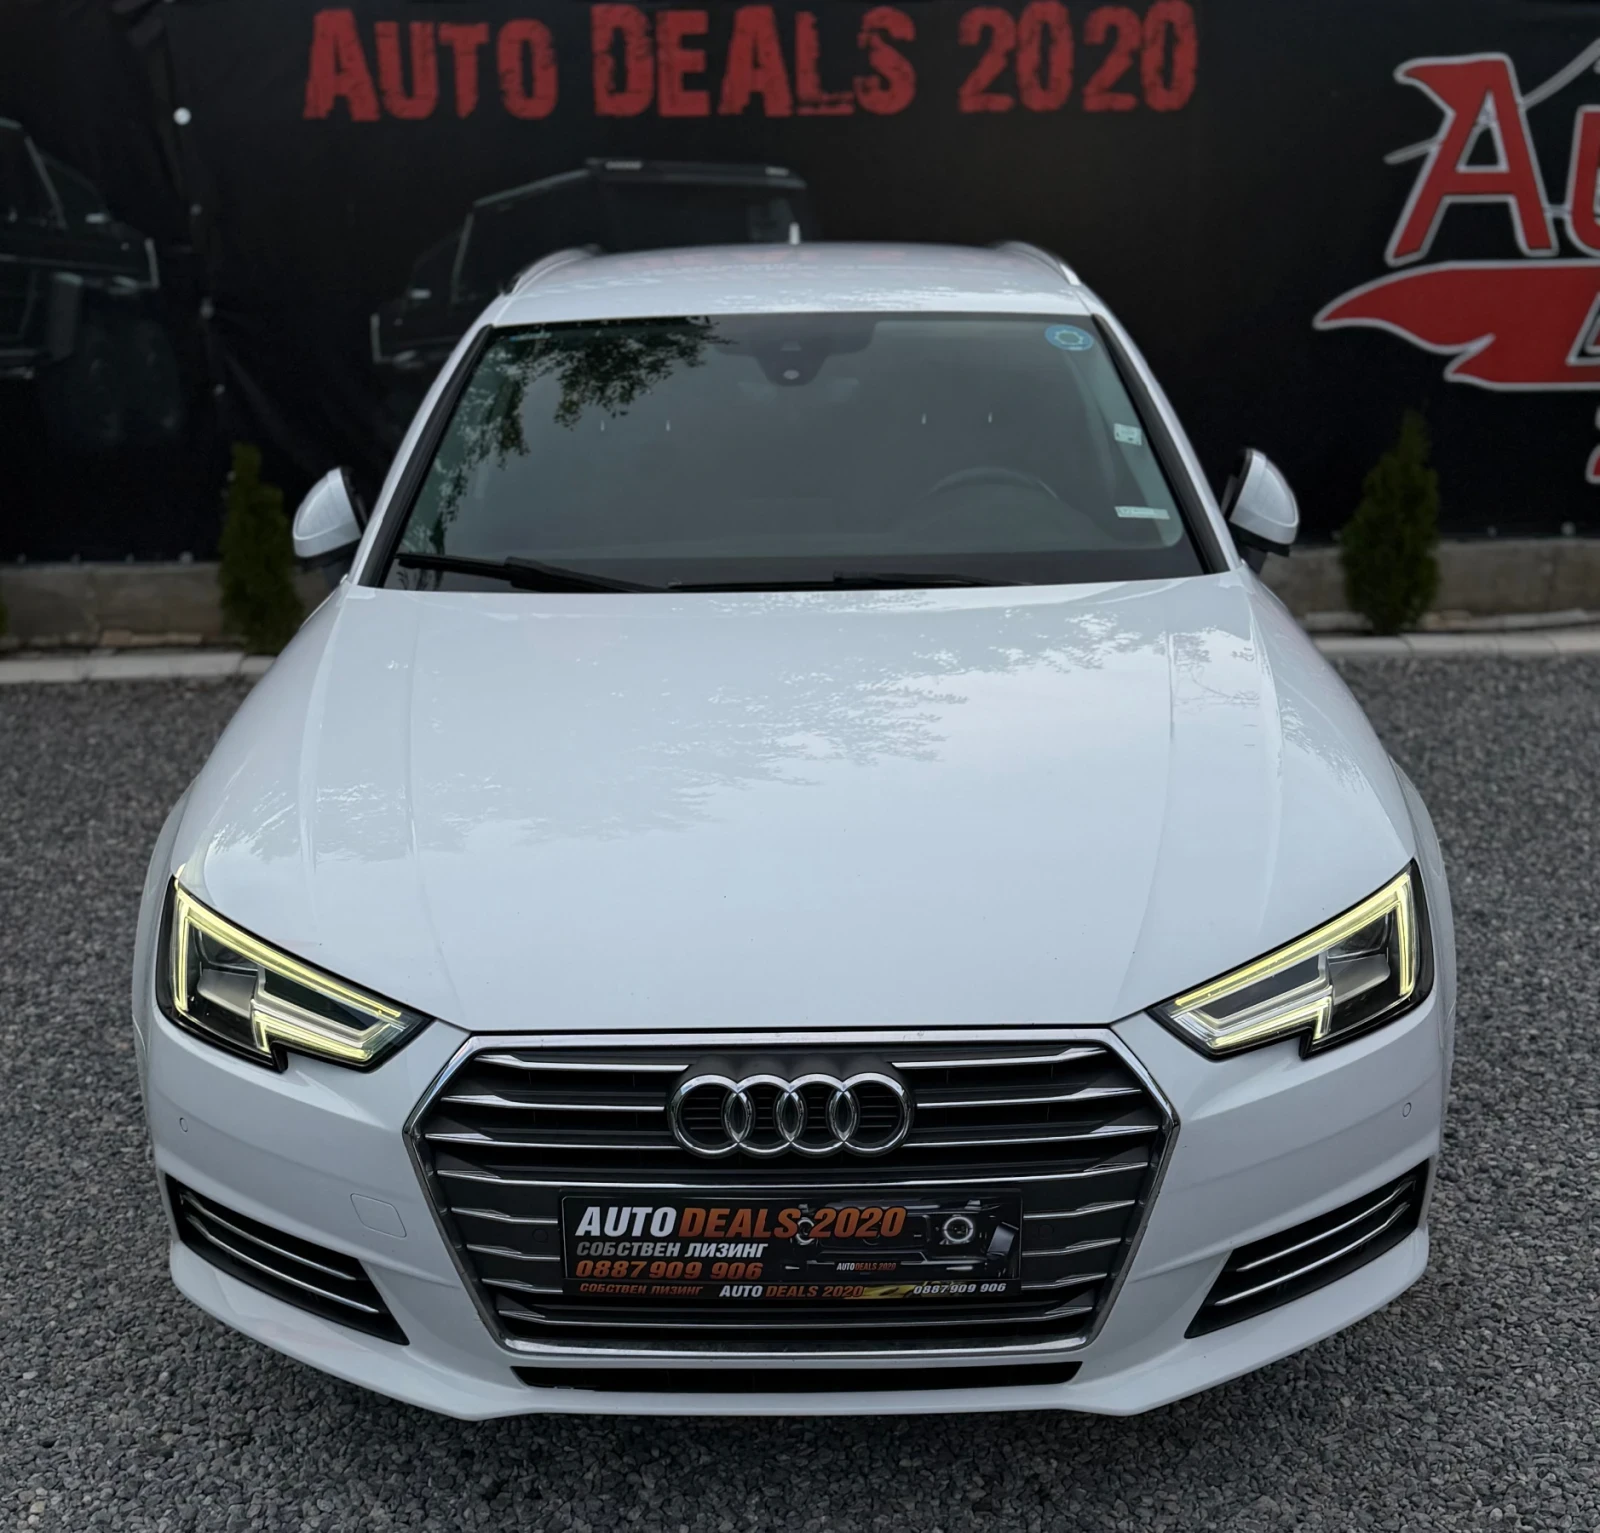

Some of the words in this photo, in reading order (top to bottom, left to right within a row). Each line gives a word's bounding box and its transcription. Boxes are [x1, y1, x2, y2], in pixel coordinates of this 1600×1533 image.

[303, 7, 558, 120] AUTO
[591, 3, 917, 117] DEALS
[958, 0, 1197, 113] 2020
[575, 1206, 677, 1237] AUTO
[678, 1207, 801, 1238] DEALS
[808, 1206, 907, 1237] 2020
[576, 1241, 681, 1257] СОБСТВЕН
[684, 1242, 769, 1258] ЛИЗИНГ
[575, 1259, 648, 1278] 0887
[649, 1260, 702, 1279] 909
[711, 1261, 764, 1280] 906
[836, 1262, 855, 1271] AUTO
[855, 1262, 877, 1271] DEALS
[579, 1282, 647, 1294] СОБСТВЕН
[719, 1285, 763, 1298] AUTO
[766, 1286, 819, 1299] DEALS
[822, 1285, 865, 1298] 2020
[913, 1284, 950, 1295] 0887
[949, 1283, 976, 1294] 909
[980, 1282, 1007, 1293] 906
